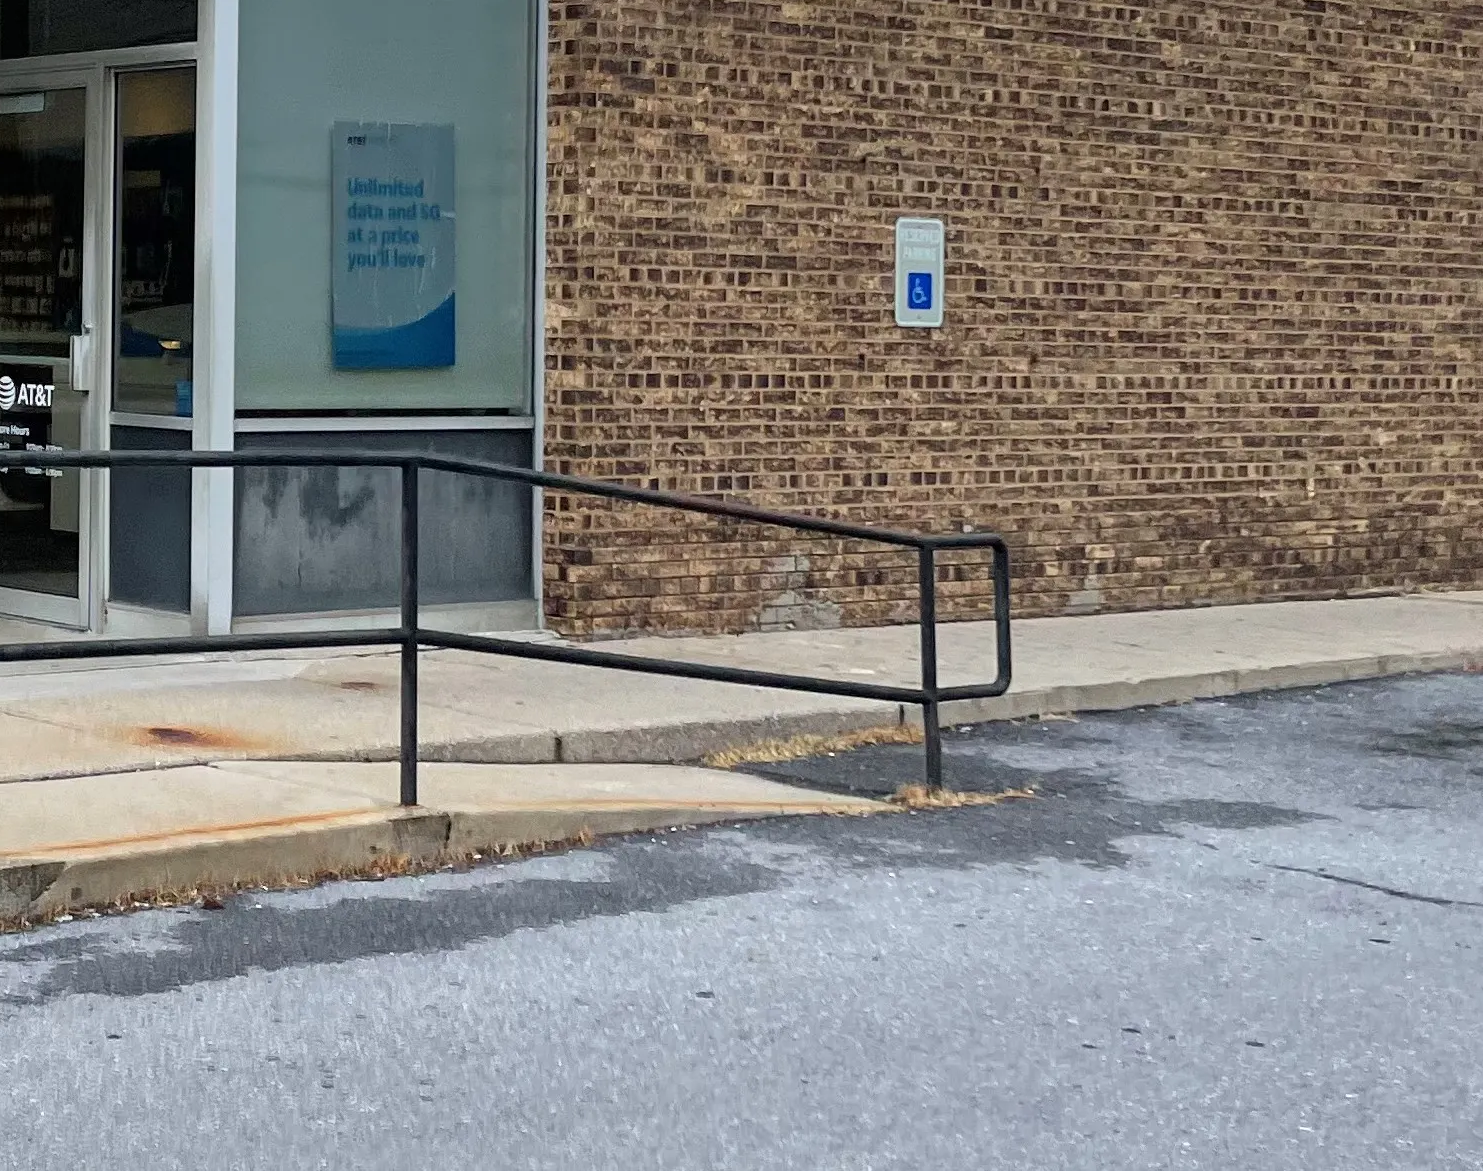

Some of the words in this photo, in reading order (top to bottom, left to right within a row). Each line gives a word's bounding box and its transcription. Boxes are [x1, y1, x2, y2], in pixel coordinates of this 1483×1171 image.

[347, 178, 424, 198] Unlimited
[347, 202, 383, 219] data
[388, 201, 416, 219] and
[347, 228, 362, 242] at
[368, 230, 377, 242] a
[382, 226, 420, 246] price
[17, 383, 55, 407] AT&T
[11, 424, 30, 436] Hours
